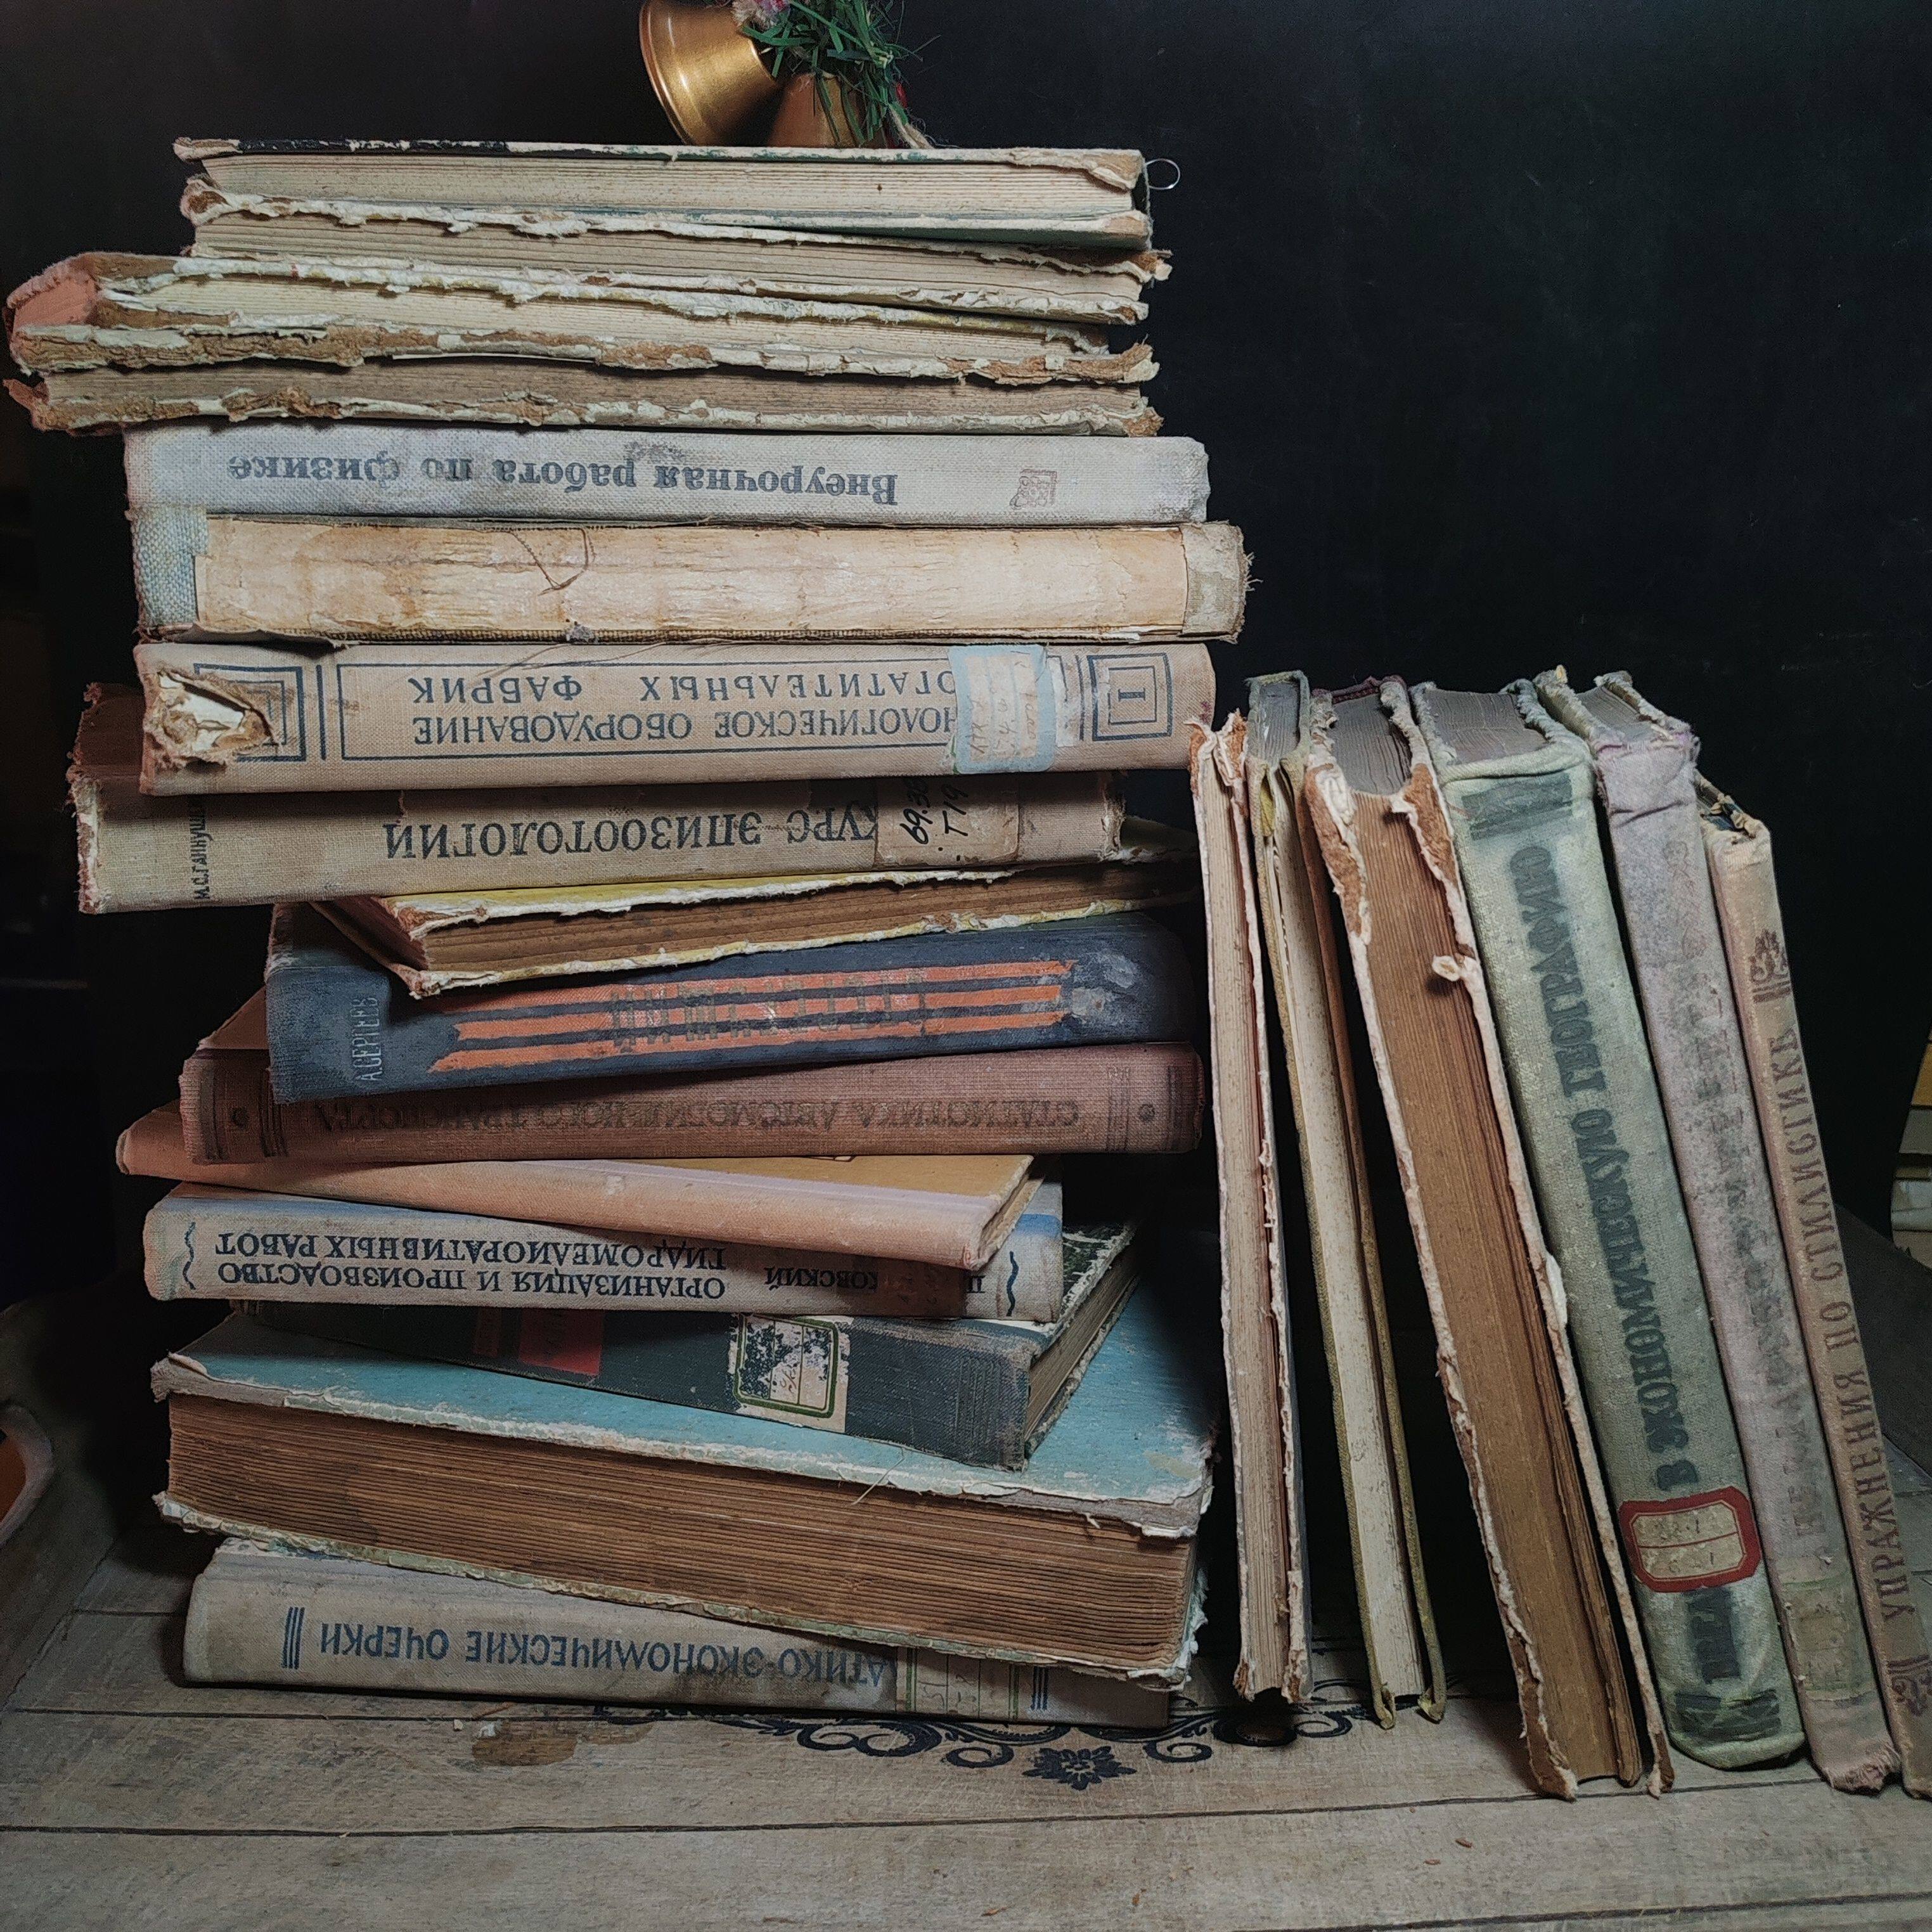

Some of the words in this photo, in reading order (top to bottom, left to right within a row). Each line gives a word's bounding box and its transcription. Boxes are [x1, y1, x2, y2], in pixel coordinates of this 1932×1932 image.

[226, 451, 401, 489] физике
[420, 459, 473, 484] по
[491, 460, 635, 494] работа
[654, 465, 899, 506] Внеурочная
[408, 675, 584, 704] ФАБРИК
[640, 669, 955, 702] ОГАТИТЕЛЬНЫХ
[412, 709, 693, 745] ОБОРУДОВАНИЕ
[382, 811, 762, 860] ЭПИЗООТОЛОГИИ
[1509, 845, 1609, 1098] ГЕОГРАФИЮ
[537, 1101, 840, 1133] АВТОМОБИЛЬНОГО
[853, 1100, 1079, 1130] СТАТИСТИКА
[1767, 1029, 1846, 1285] СТИЛИСТИКЕ
[214, 1232, 316, 1259] РАБОТ
[322, 1235, 726, 1270] ГИДРОМЕЛИОРАТИВНЫХ
[217, 1262, 467, 1292] ПРОИЗВОДСТВО
[476, 1270, 501, 1292] И
[511, 1267, 725, 1301] ОРГАНИЗАЦИЯ
[1569, 1107, 1690, 1455] ЭКОНОМИЧЕСКУЮ
[1817, 1299, 1860, 1353] ПО
[1829, 1367, 1916, 1621] УПРАЖНЕНИЯ
[321, 1623, 450, 1661] ОЧЕРКИ
